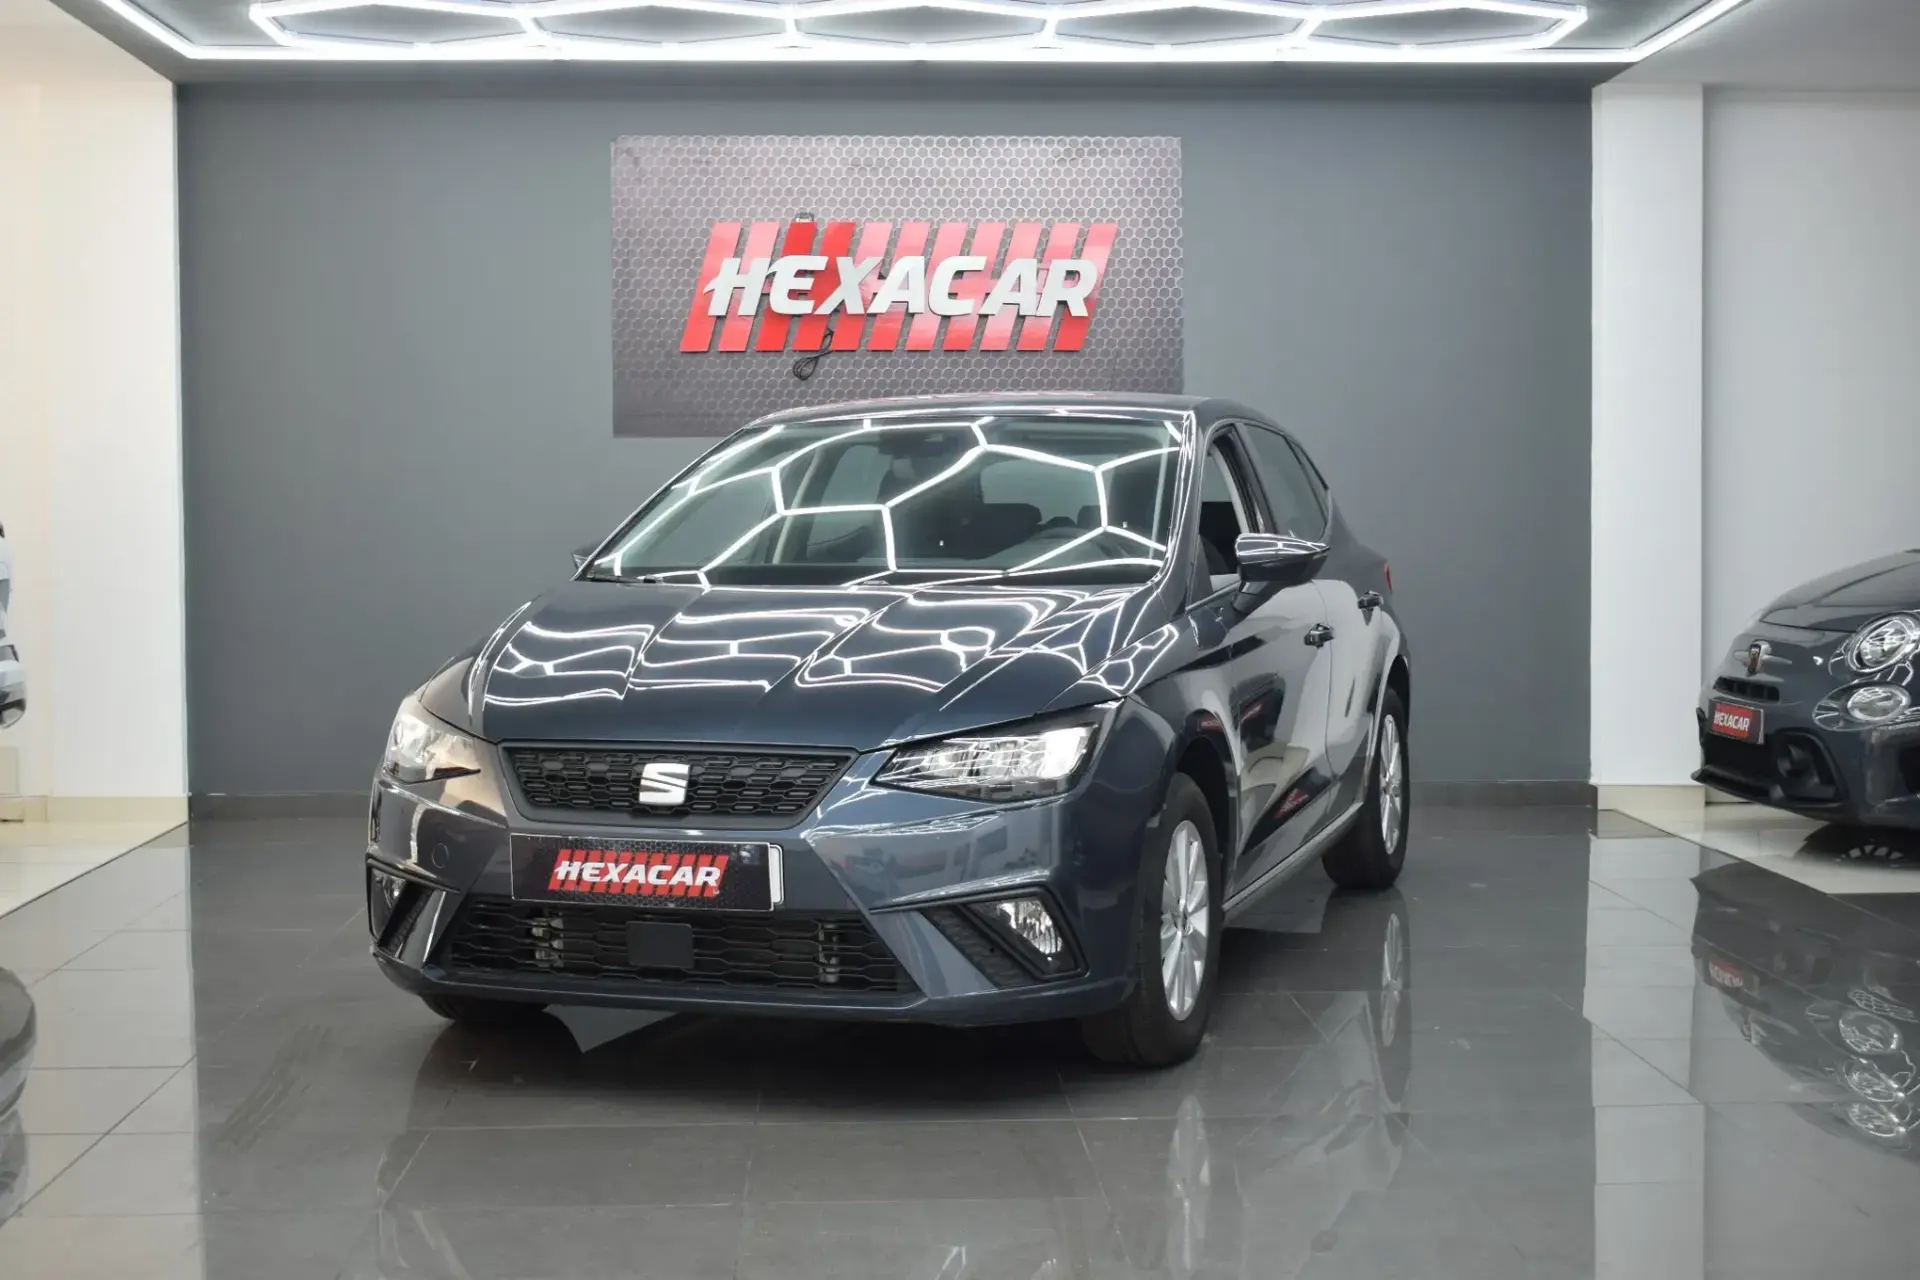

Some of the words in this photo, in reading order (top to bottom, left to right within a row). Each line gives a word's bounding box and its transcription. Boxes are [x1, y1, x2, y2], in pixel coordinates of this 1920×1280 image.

[702, 254, 1099, 317] HEXACAR
[1713, 710, 1751, 732] HEXACAR
[554, 860, 721, 888] HEXACAR
